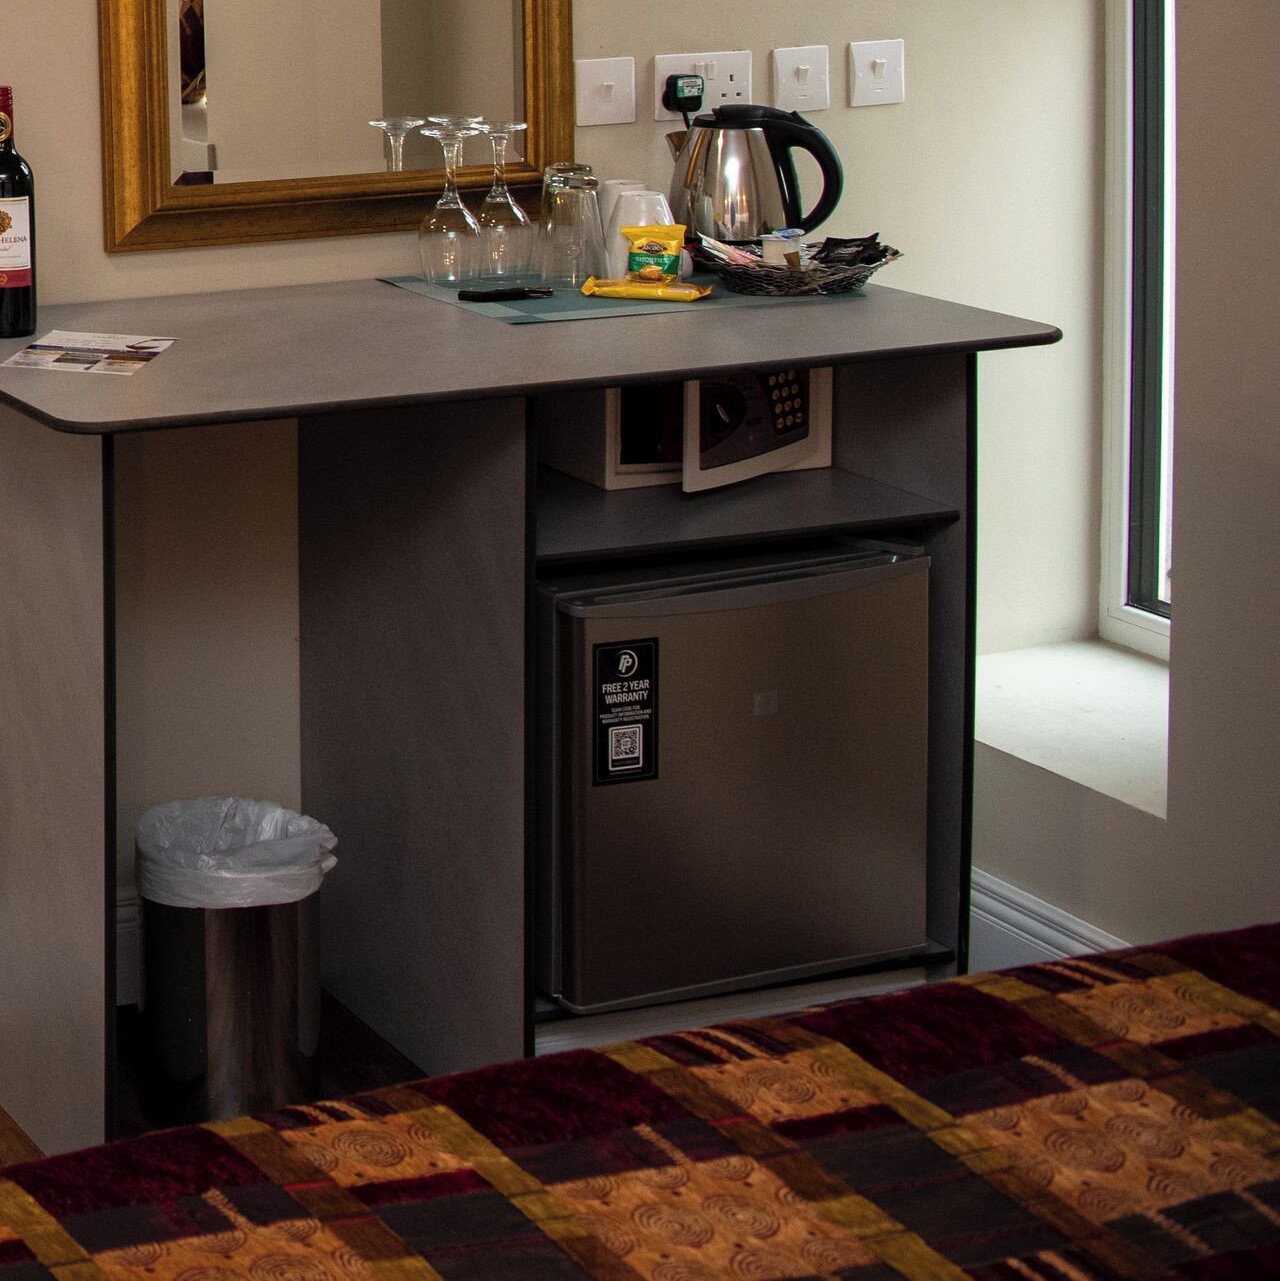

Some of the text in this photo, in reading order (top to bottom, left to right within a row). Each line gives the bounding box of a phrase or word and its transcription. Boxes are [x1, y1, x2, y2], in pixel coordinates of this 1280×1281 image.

[602, 679, 650, 694] FREE 2 YEAR
[604, 690, 649, 705] WARRANTY
